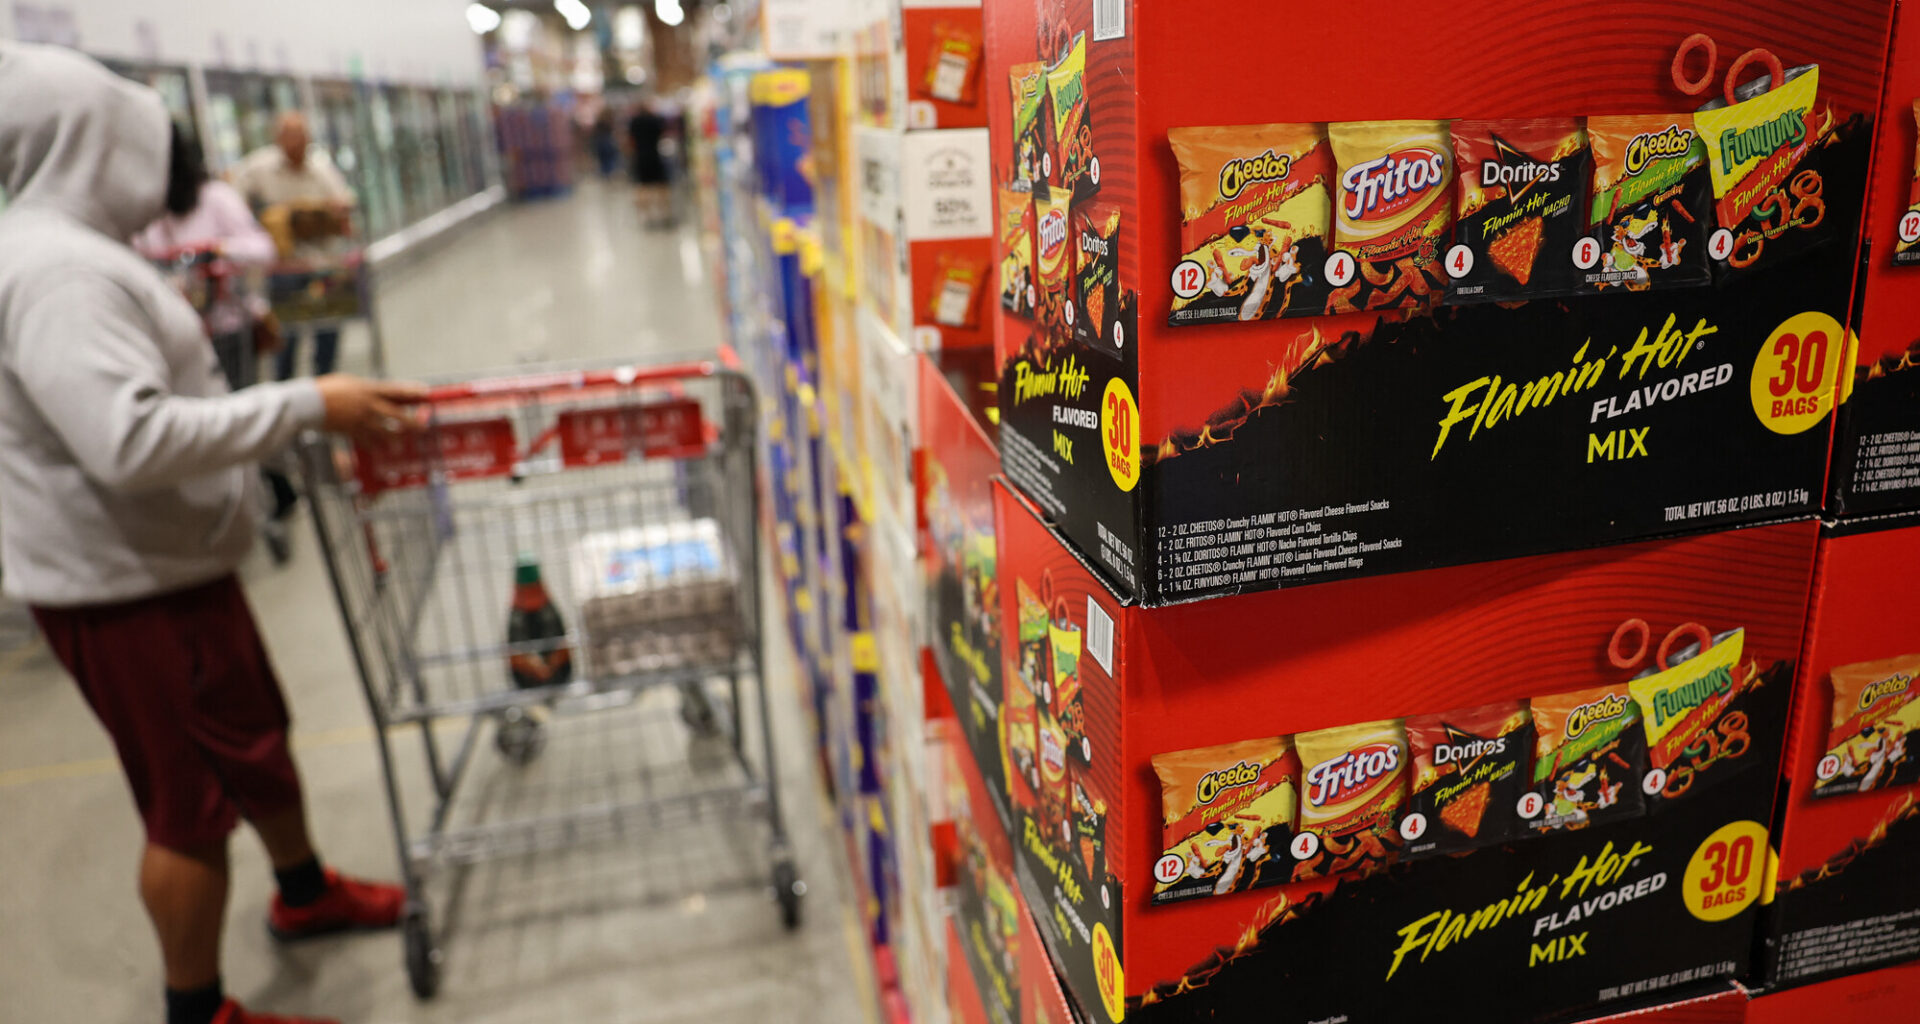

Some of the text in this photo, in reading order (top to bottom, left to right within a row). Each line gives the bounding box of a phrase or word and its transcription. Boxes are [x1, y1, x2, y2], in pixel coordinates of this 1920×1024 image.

[1627, 128, 1690, 174] Cheetos
[1720, 107, 1806, 176] FUNYUNS
[1220, 150, 1290, 199] Cheetos
[1342, 154, 1444, 221] Fritos
[1484, 162, 1560, 185] Doritos
[1628, 169, 1665, 200] Flamin'
[1668, 158, 1688, 174] Hot
[1733, 151, 1794, 216] Flamin' Hot
[1224, 194, 1265, 226] Flamin'
[1266, 182, 1287, 201] Hot
[1483, 204, 1526, 240] Flamin'
[1527, 192, 1551, 212] Hot
[1542, 194, 1570, 217] NACHO
[1040, 212, 1066, 256] Fritos
[1083, 232, 1108, 256] Doritos
[1716, 235, 1725, 254] 4
[1747, 216, 1805, 244] Onion Flavored Rings
[1905, 217, 1919, 236] 12
[1334, 259, 1344, 279] 4
[1454, 251, 1464, 271] 4
[1581, 243, 1592, 263] 6
[1180, 268, 1198, 290] 12
[1176, 306, 1237, 319] CHEESE FLAVORED SNACKS
[1768, 330, 1828, 398] 30
[1431, 337, 1618, 462] Flamin'
[1590, 363, 1734, 423] FLAVORED
[1770, 396, 1818, 418] BAGS
[1053, 405, 1098, 429] FLAVORED
[1109, 392, 1130, 458] 30
[1053, 429, 1073, 464] MIX
[1586, 426, 1650, 463] MIX
[1112, 452, 1131, 479] BAGS
[1158, 526, 1166, 538] 12
[1172, 525, 1177, 536] 2
[1178, 524, 1189, 535] OZ.
[1190, 519, 1225, 534] CHEETOS®
[1226, 516, 1250, 529] Crunchy
[1278, 510, 1298, 522] HOT®
[1300, 506, 1323, 519] Flavored
[1324, 505, 1345, 516] Cheese
[1346, 501, 1369, 514] Flavored
[1370, 498, 1389, 511] Snacks
[1664, 488, 1809, 521] TOTAL NET WT. 56 OZ. (3 LBS. 8 OZ.) 1.5 kg
[1158, 541, 1162, 552] 4
[1169, 540, 1173, 551] 2
[1174, 539, 1185, 550] OZ.
[1186, 534, 1216, 548] FRITOS®
[1244, 528, 1265, 541] HOT®
[1266, 525, 1290, 538] Flavored
[1292, 524, 1304, 534] Corn
[1306, 521, 1321, 534] Chips
[1158, 555, 1162, 566] 4
[1183, 551, 1193, 562] OZ.
[1194, 547, 1229, 561] DORITOS®
[1256, 540, 1277, 552] HOT®
[1278, 538, 1296, 550] Nacho
[1298, 535, 1322, 548] Flavored
[1323, 532, 1341, 544] Tortilla
[1342, 530, 1357, 543] Chips
[1158, 569, 1162, 580] 6
[1169, 568, 1173, 579] 2
[1175, 566, 1185, 578] OZ.
[1186, 561, 1220, 576] CHEETOS®
[1222, 559, 1246, 571] Crunchy
[1273, 552, 1293, 564] HOT®
[1313, 545, 1337, 559] Flavored
[1338, 544, 1358, 555] Cheese
[1359, 540, 1382, 552] Flavored
[1383, 537, 1402, 549] Snacks
[1158, 584, 1162, 594] 4
[1183, 579, 1193, 590] OZ.
[1259, 568, 1280, 579] HOT®
[1280, 564, 1305, 577] Flavored
[1306, 561, 1322, 574] Onion
[1324, 558, 1347, 571] Flavored
[1348, 557, 1363, 568] Rings
[1654, 662, 1733, 727] FUNYUNS
[1860, 675, 1910, 710] Cheetos
[1567, 696, 1627, 738] Cheetos
[1435, 738, 1506, 764] Doritos
[1822, 759, 1836, 776] 12
[1198, 762, 1260, 804] Cheetos
[1238, 785, 1257, 800] Hot
[1307, 745, 1399, 807] Fritos
[1434, 774, 1473, 808] Flamin'
[1475, 761, 1497, 780] Hot
[1650, 773, 1658, 789] 4
[1526, 797, 1535, 814] 6
[1409, 818, 1418, 834] 4
[1300, 837, 1309, 854] 4
[1700, 835, 1754, 892] 30
[1161, 859, 1178, 878] 12
[1532, 872, 1668, 937] FLAVORED
[1702, 886, 1747, 910] BAGS
[1386, 870, 1558, 983] Flamin'
[1098, 932, 1115, 996] 30
[1528, 931, 1589, 968] MIX
